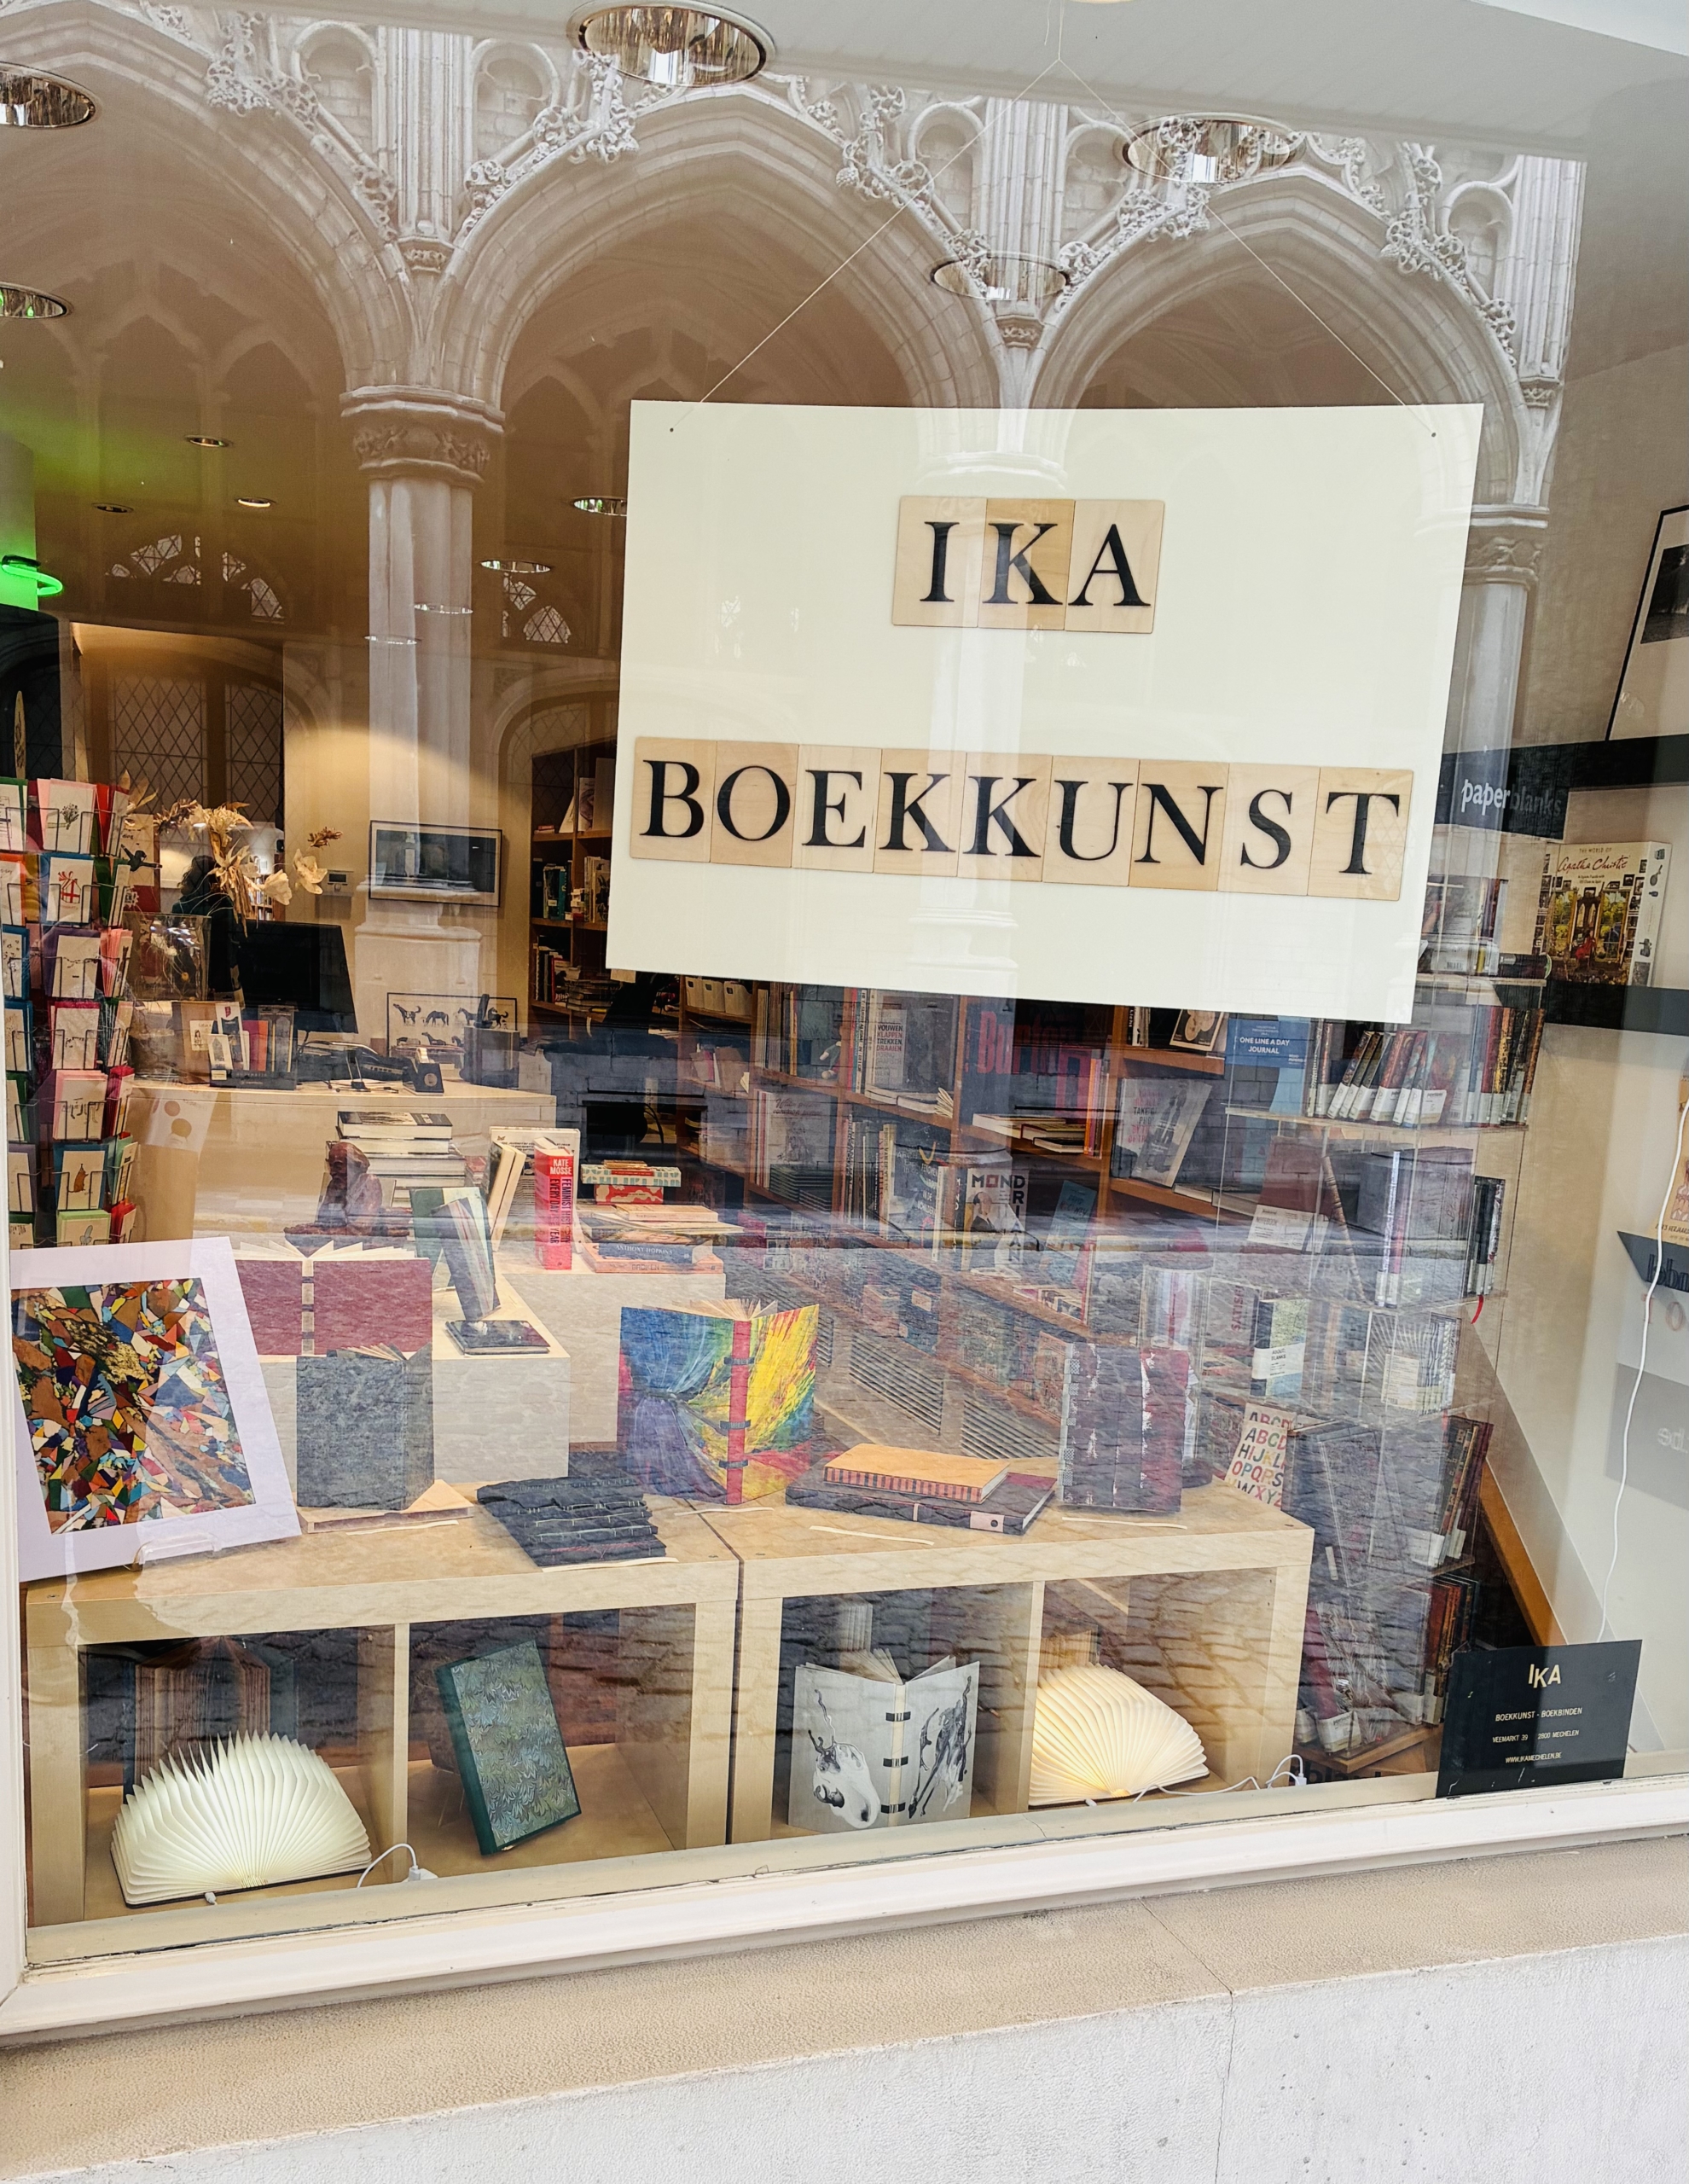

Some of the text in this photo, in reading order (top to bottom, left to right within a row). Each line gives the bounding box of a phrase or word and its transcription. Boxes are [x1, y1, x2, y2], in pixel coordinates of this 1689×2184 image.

[920, 520, 1152, 607] IKA
[1461, 779, 1562, 816] paperblanks
[638, 759, 1401, 875] BOEKKUNST
[1557, 855, 1629, 874] Agatha Christie
[550, 1178, 560, 1199] EVERY
[561, 1178, 572, 1211] FEMINIST
[549, 1199, 559, 1212] DAY
[548, 1227, 559, 1244] YEAR
[1528, 1664, 1561, 1688] IKA
[1495, 1711, 1535, 1722] BOEKKUNST
[1541, 1707, 1582, 1717] BOEKBINDEN
[1492, 1734, 1519, 1743] VEEMARKT
[1505, 1751, 1562, 1763] WWW.IKAMECHELEN.BE
